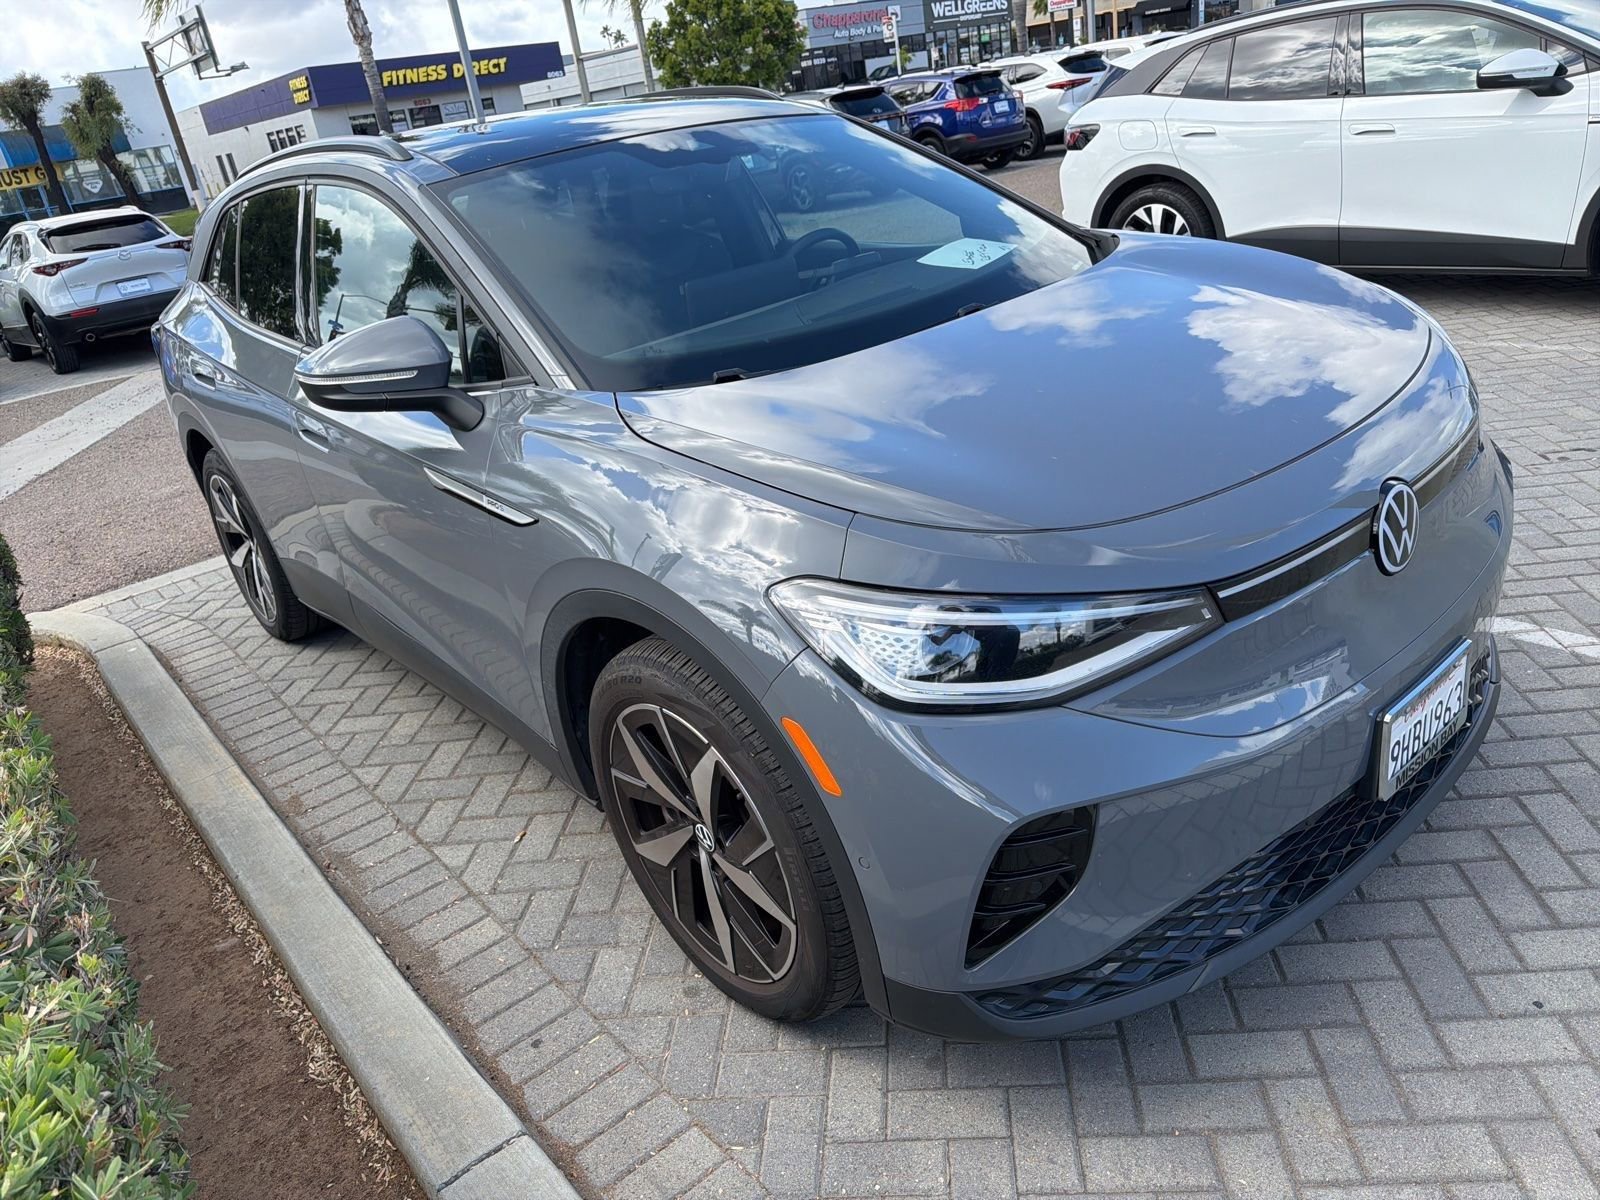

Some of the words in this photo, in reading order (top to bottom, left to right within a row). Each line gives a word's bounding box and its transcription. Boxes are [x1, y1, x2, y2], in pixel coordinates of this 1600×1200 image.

[931, 0, 1008, 17] WELLGREENS
[834, 29, 849, 38] Auto
[850, 26, 866, 36] Body
[382, 63, 448, 87] FITNESS
[453, 57, 507, 79] DRECT
[0, 168, 31, 187] UST
[1390, 680, 1463, 778] 9HBU963
[1395, 741, 1439, 790] MISSION
[1440, 718, 1458, 749] BAY
